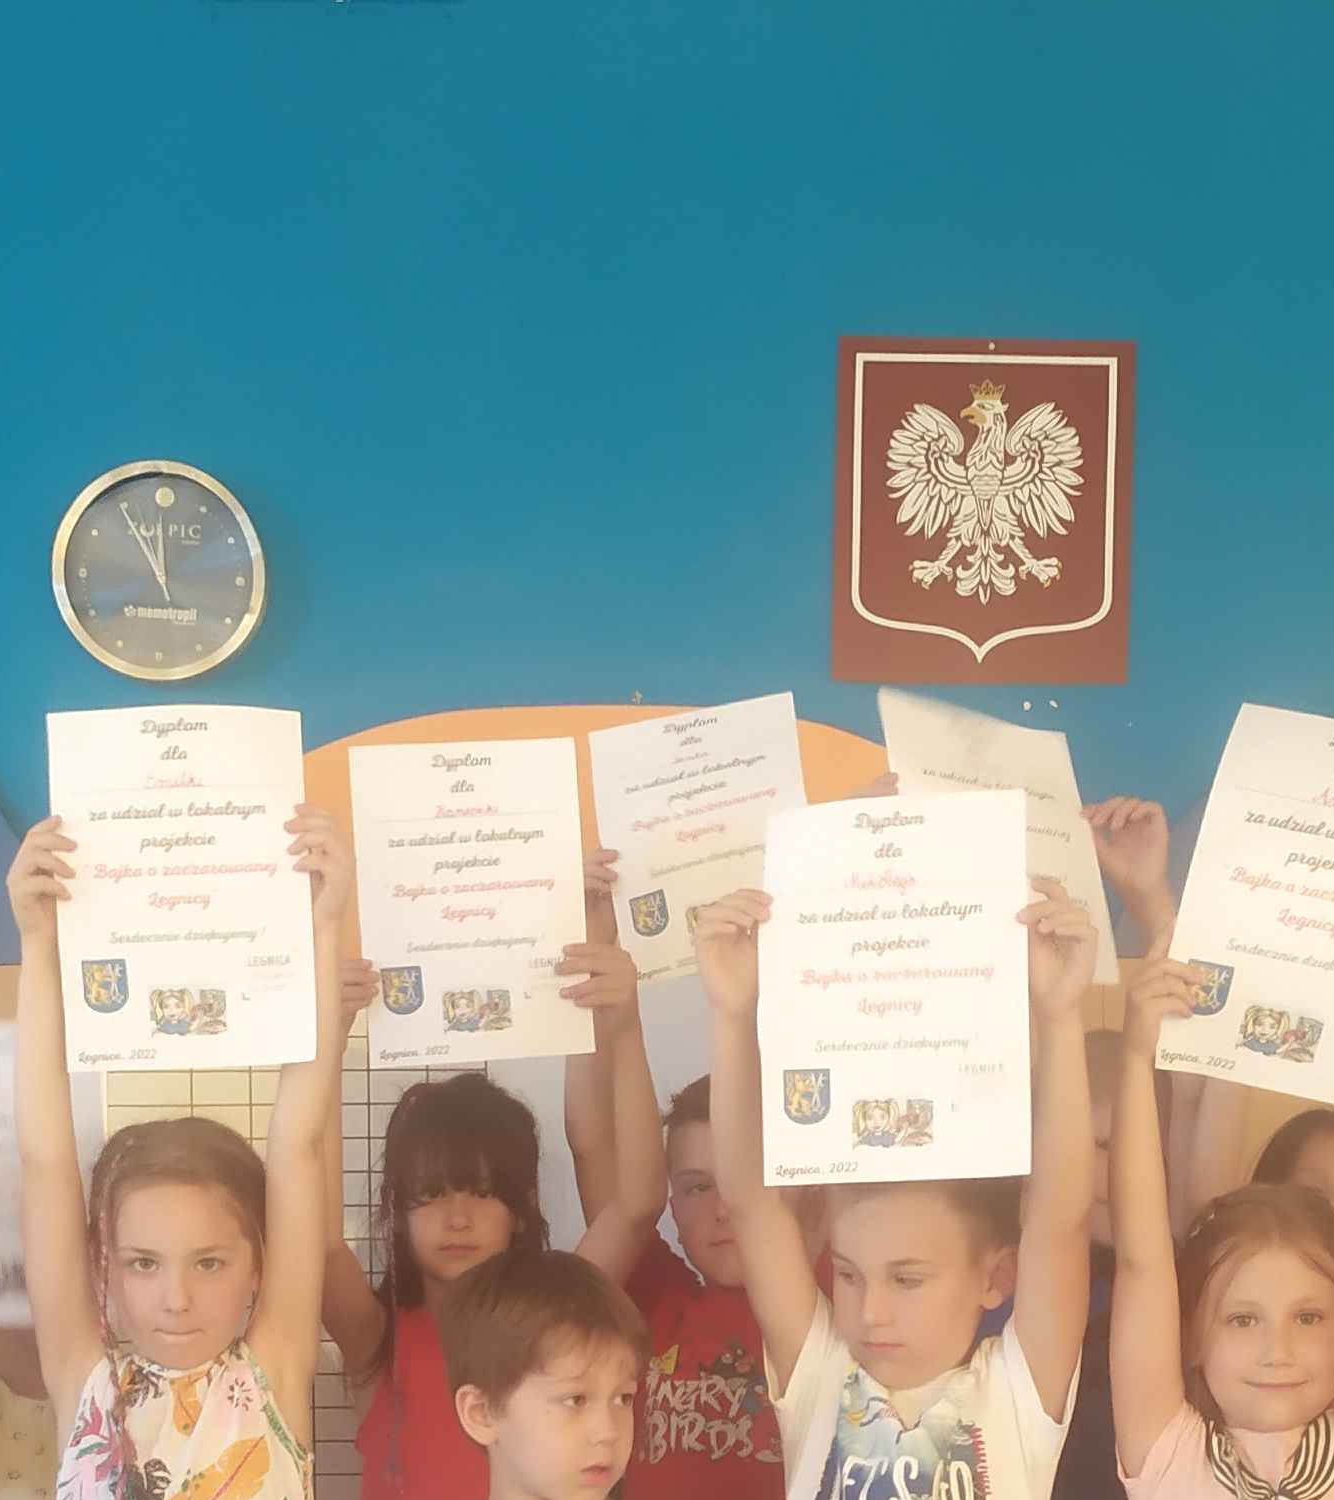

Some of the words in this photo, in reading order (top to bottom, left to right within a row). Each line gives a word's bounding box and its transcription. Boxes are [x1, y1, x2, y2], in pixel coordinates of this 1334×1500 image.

[140, 717, 210, 739] Dyplom
[160, 745, 188, 761] dla
[430, 753, 492, 773] Dyplom
[449, 779, 476, 794] dla
[88, 808, 108, 822] za
[168, 807, 184, 819] w
[186, 800, 267, 820] lokalnym
[1243, 808, 1267, 825] za
[851, 811, 926, 835] Dyplom
[139, 831, 217, 854] projekcie
[458, 834, 473, 845] w
[474, 827, 545, 845] lokalnym
[874, 841, 903, 859] dla
[797, 911, 819, 924] za
[881, 908, 898, 921] w
[901, 899, 984, 922] lokalnym
[851, 934, 930, 959] projekcie
[650, 1409, 754, 1464] BIRDS
